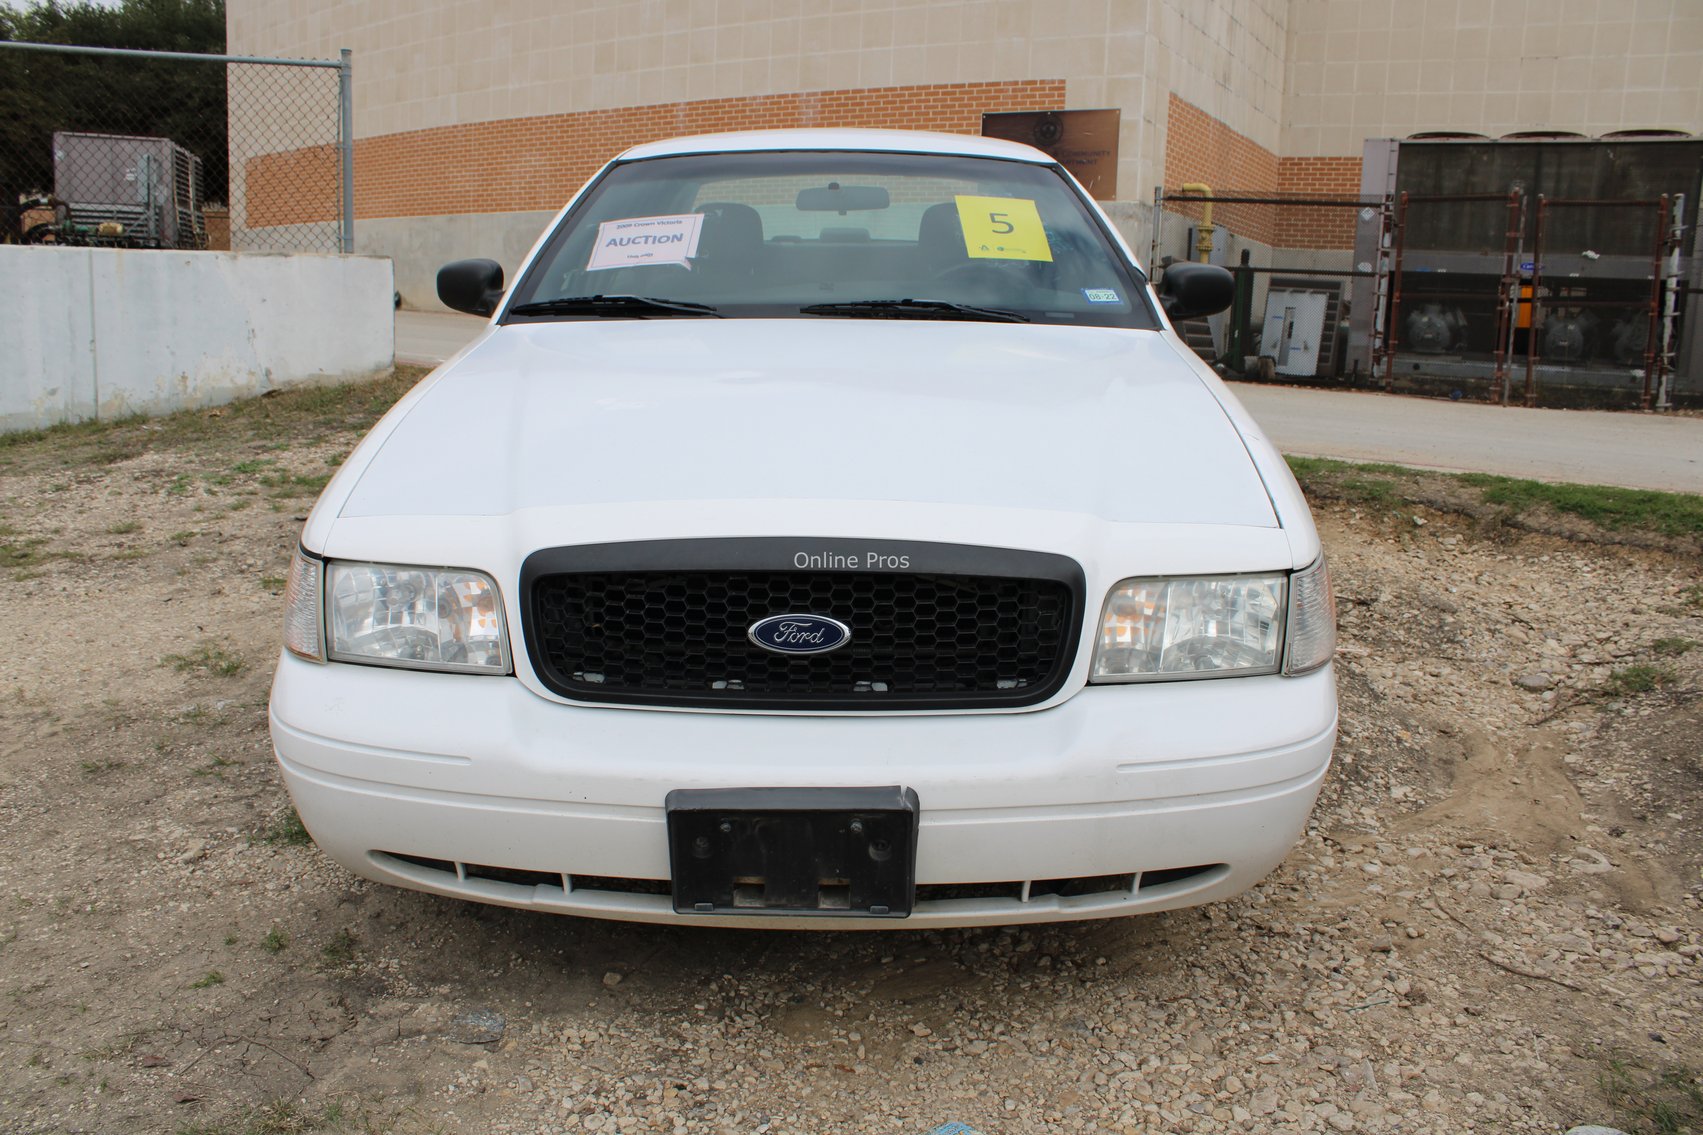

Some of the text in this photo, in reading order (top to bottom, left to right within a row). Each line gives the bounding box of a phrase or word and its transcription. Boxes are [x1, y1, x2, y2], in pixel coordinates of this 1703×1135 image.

[989, 212, 1014, 234] 5
[605, 233, 684, 248] AUCTION
[773, 621, 826, 644] Ford
